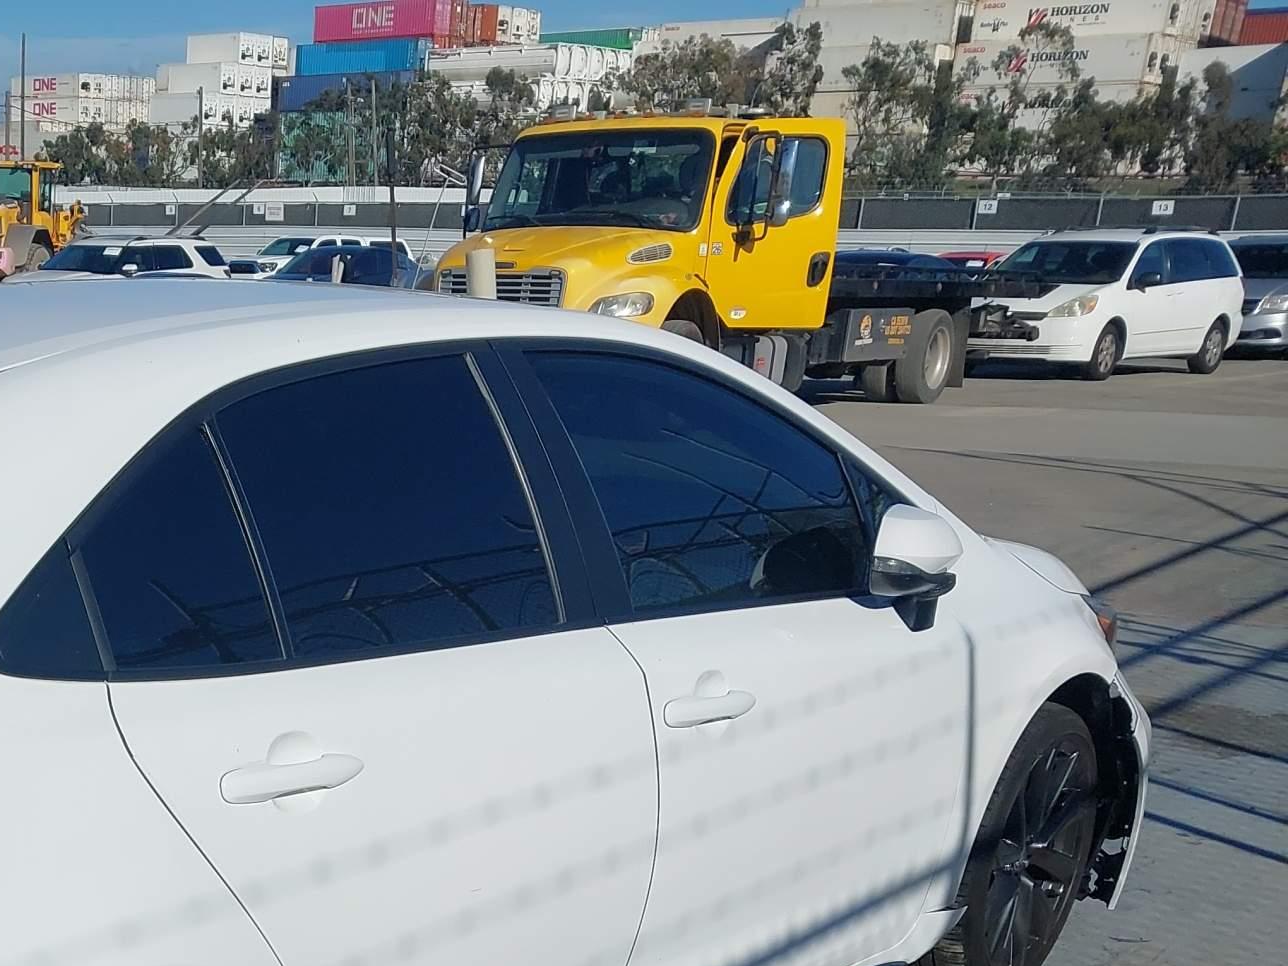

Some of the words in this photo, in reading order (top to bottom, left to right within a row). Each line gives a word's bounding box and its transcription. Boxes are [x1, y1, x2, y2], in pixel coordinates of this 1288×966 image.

[351, 5, 394, 29] ONE
[1050, 3, 1110, 17] HORIZON
[1030, 50, 1090, 62] HORIZON
[33, 77, 57, 92] ONE
[33, 102, 57, 116] ONE
[983, 203, 993, 211] 12
[1158, 204, 1168, 212] 13
